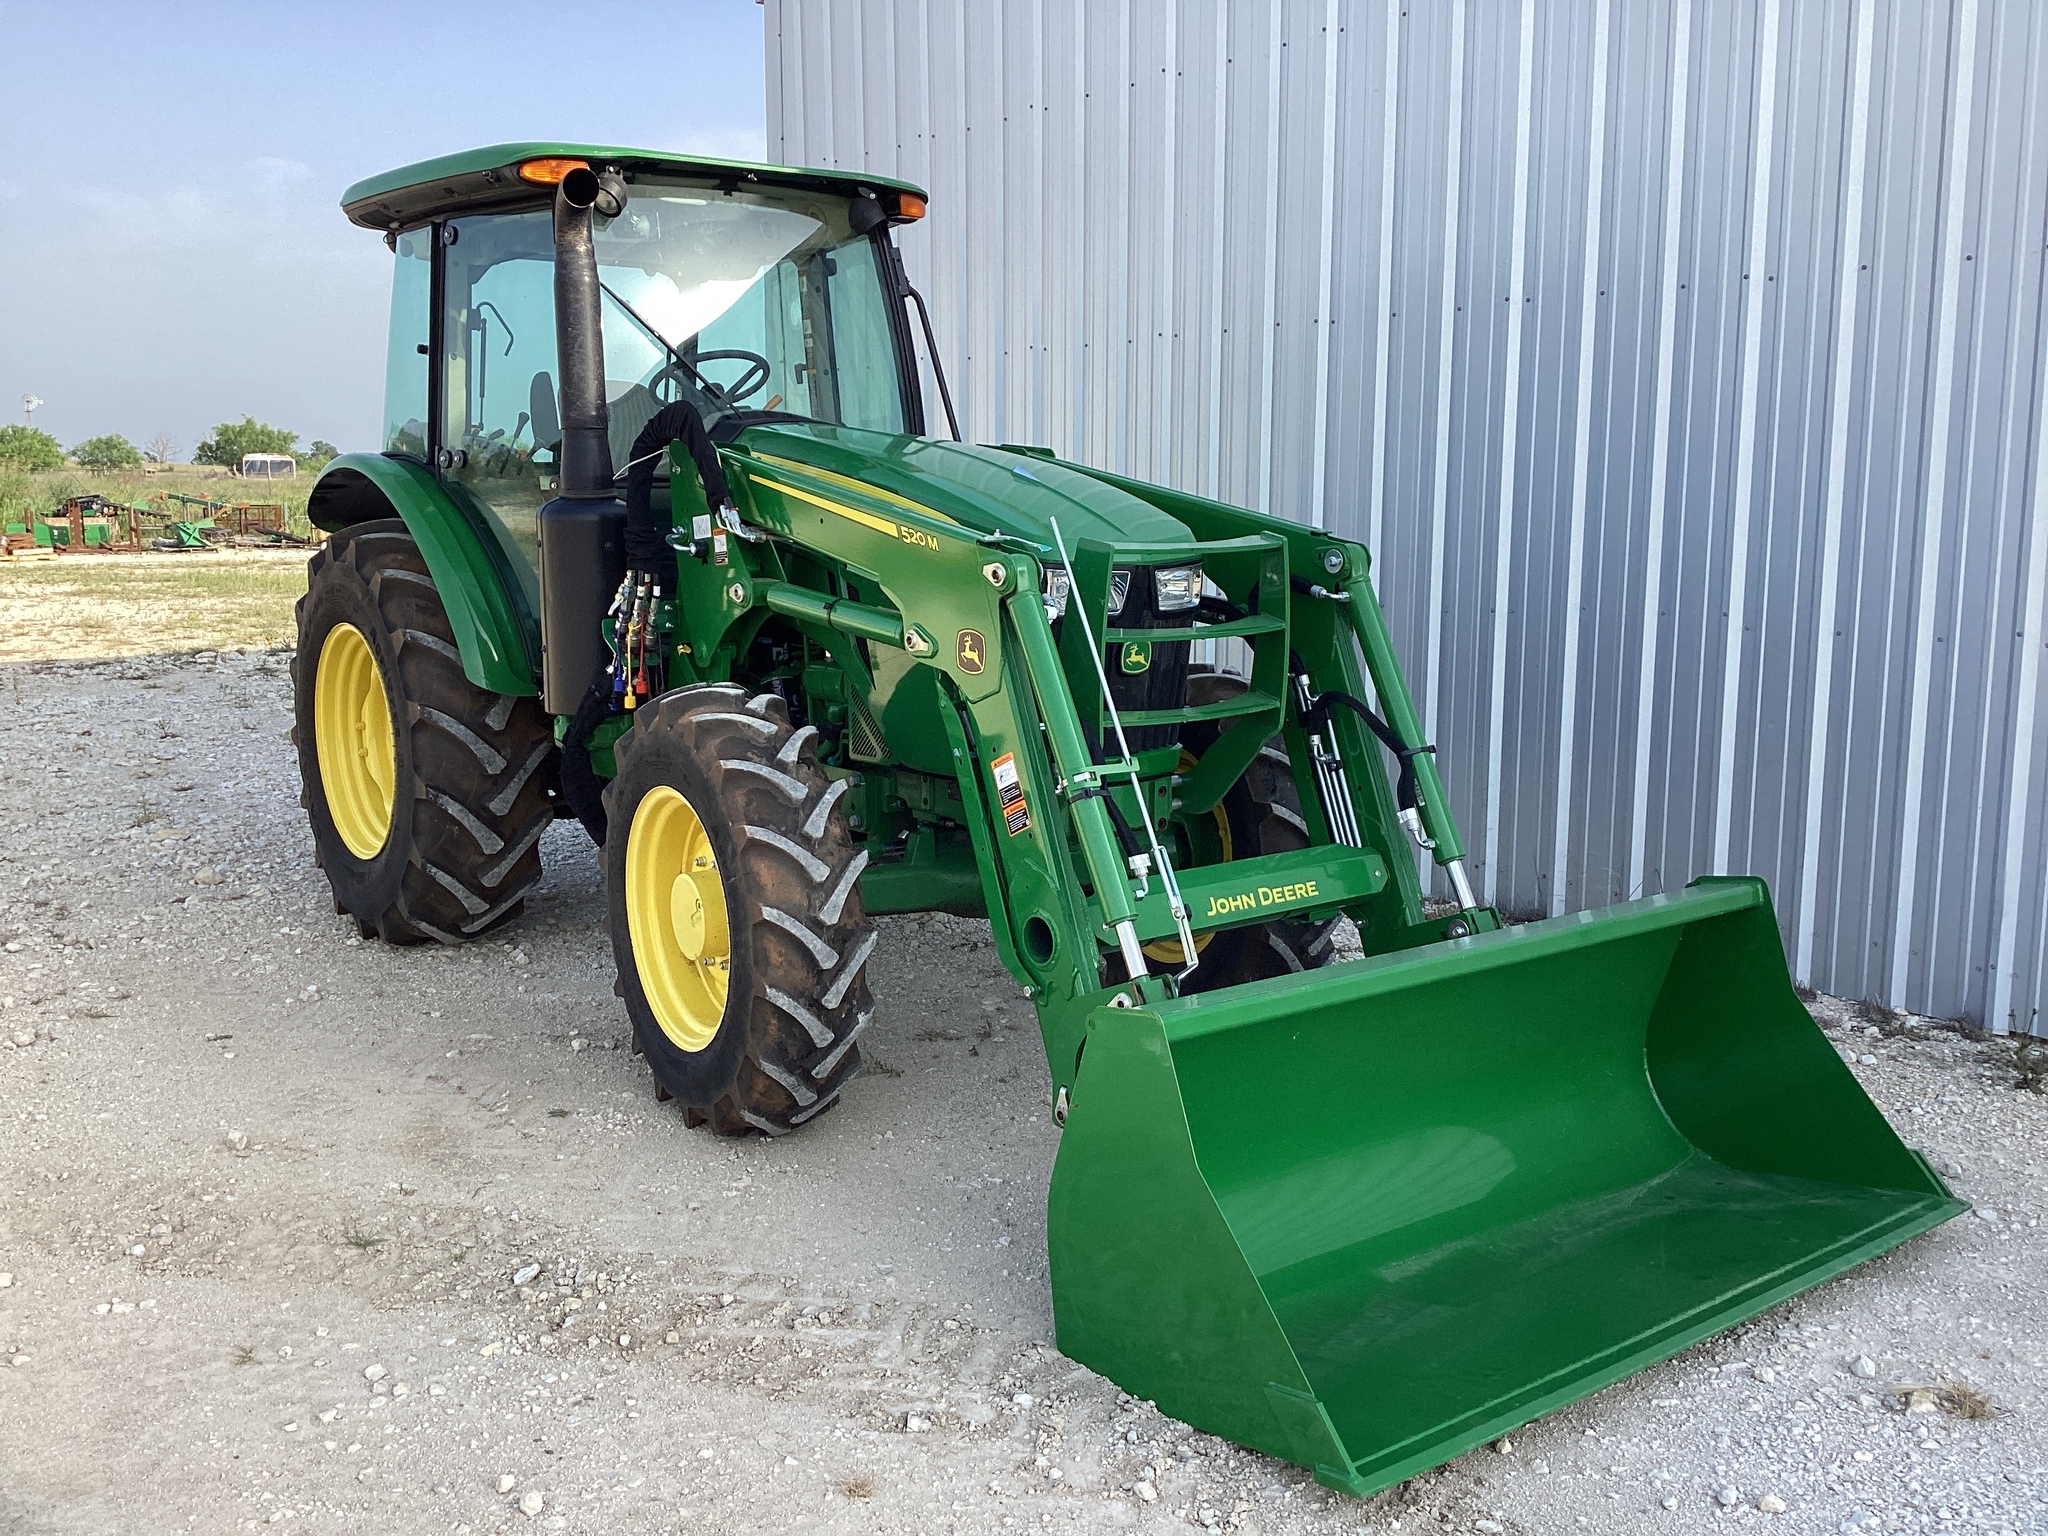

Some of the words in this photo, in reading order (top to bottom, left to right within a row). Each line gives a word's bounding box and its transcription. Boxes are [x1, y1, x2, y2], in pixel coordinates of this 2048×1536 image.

[900, 525, 926, 546] 520
[926, 534, 939, 551] M
[1207, 892, 1256, 916] JOHN
[1257, 881, 1319, 906] DEERE
